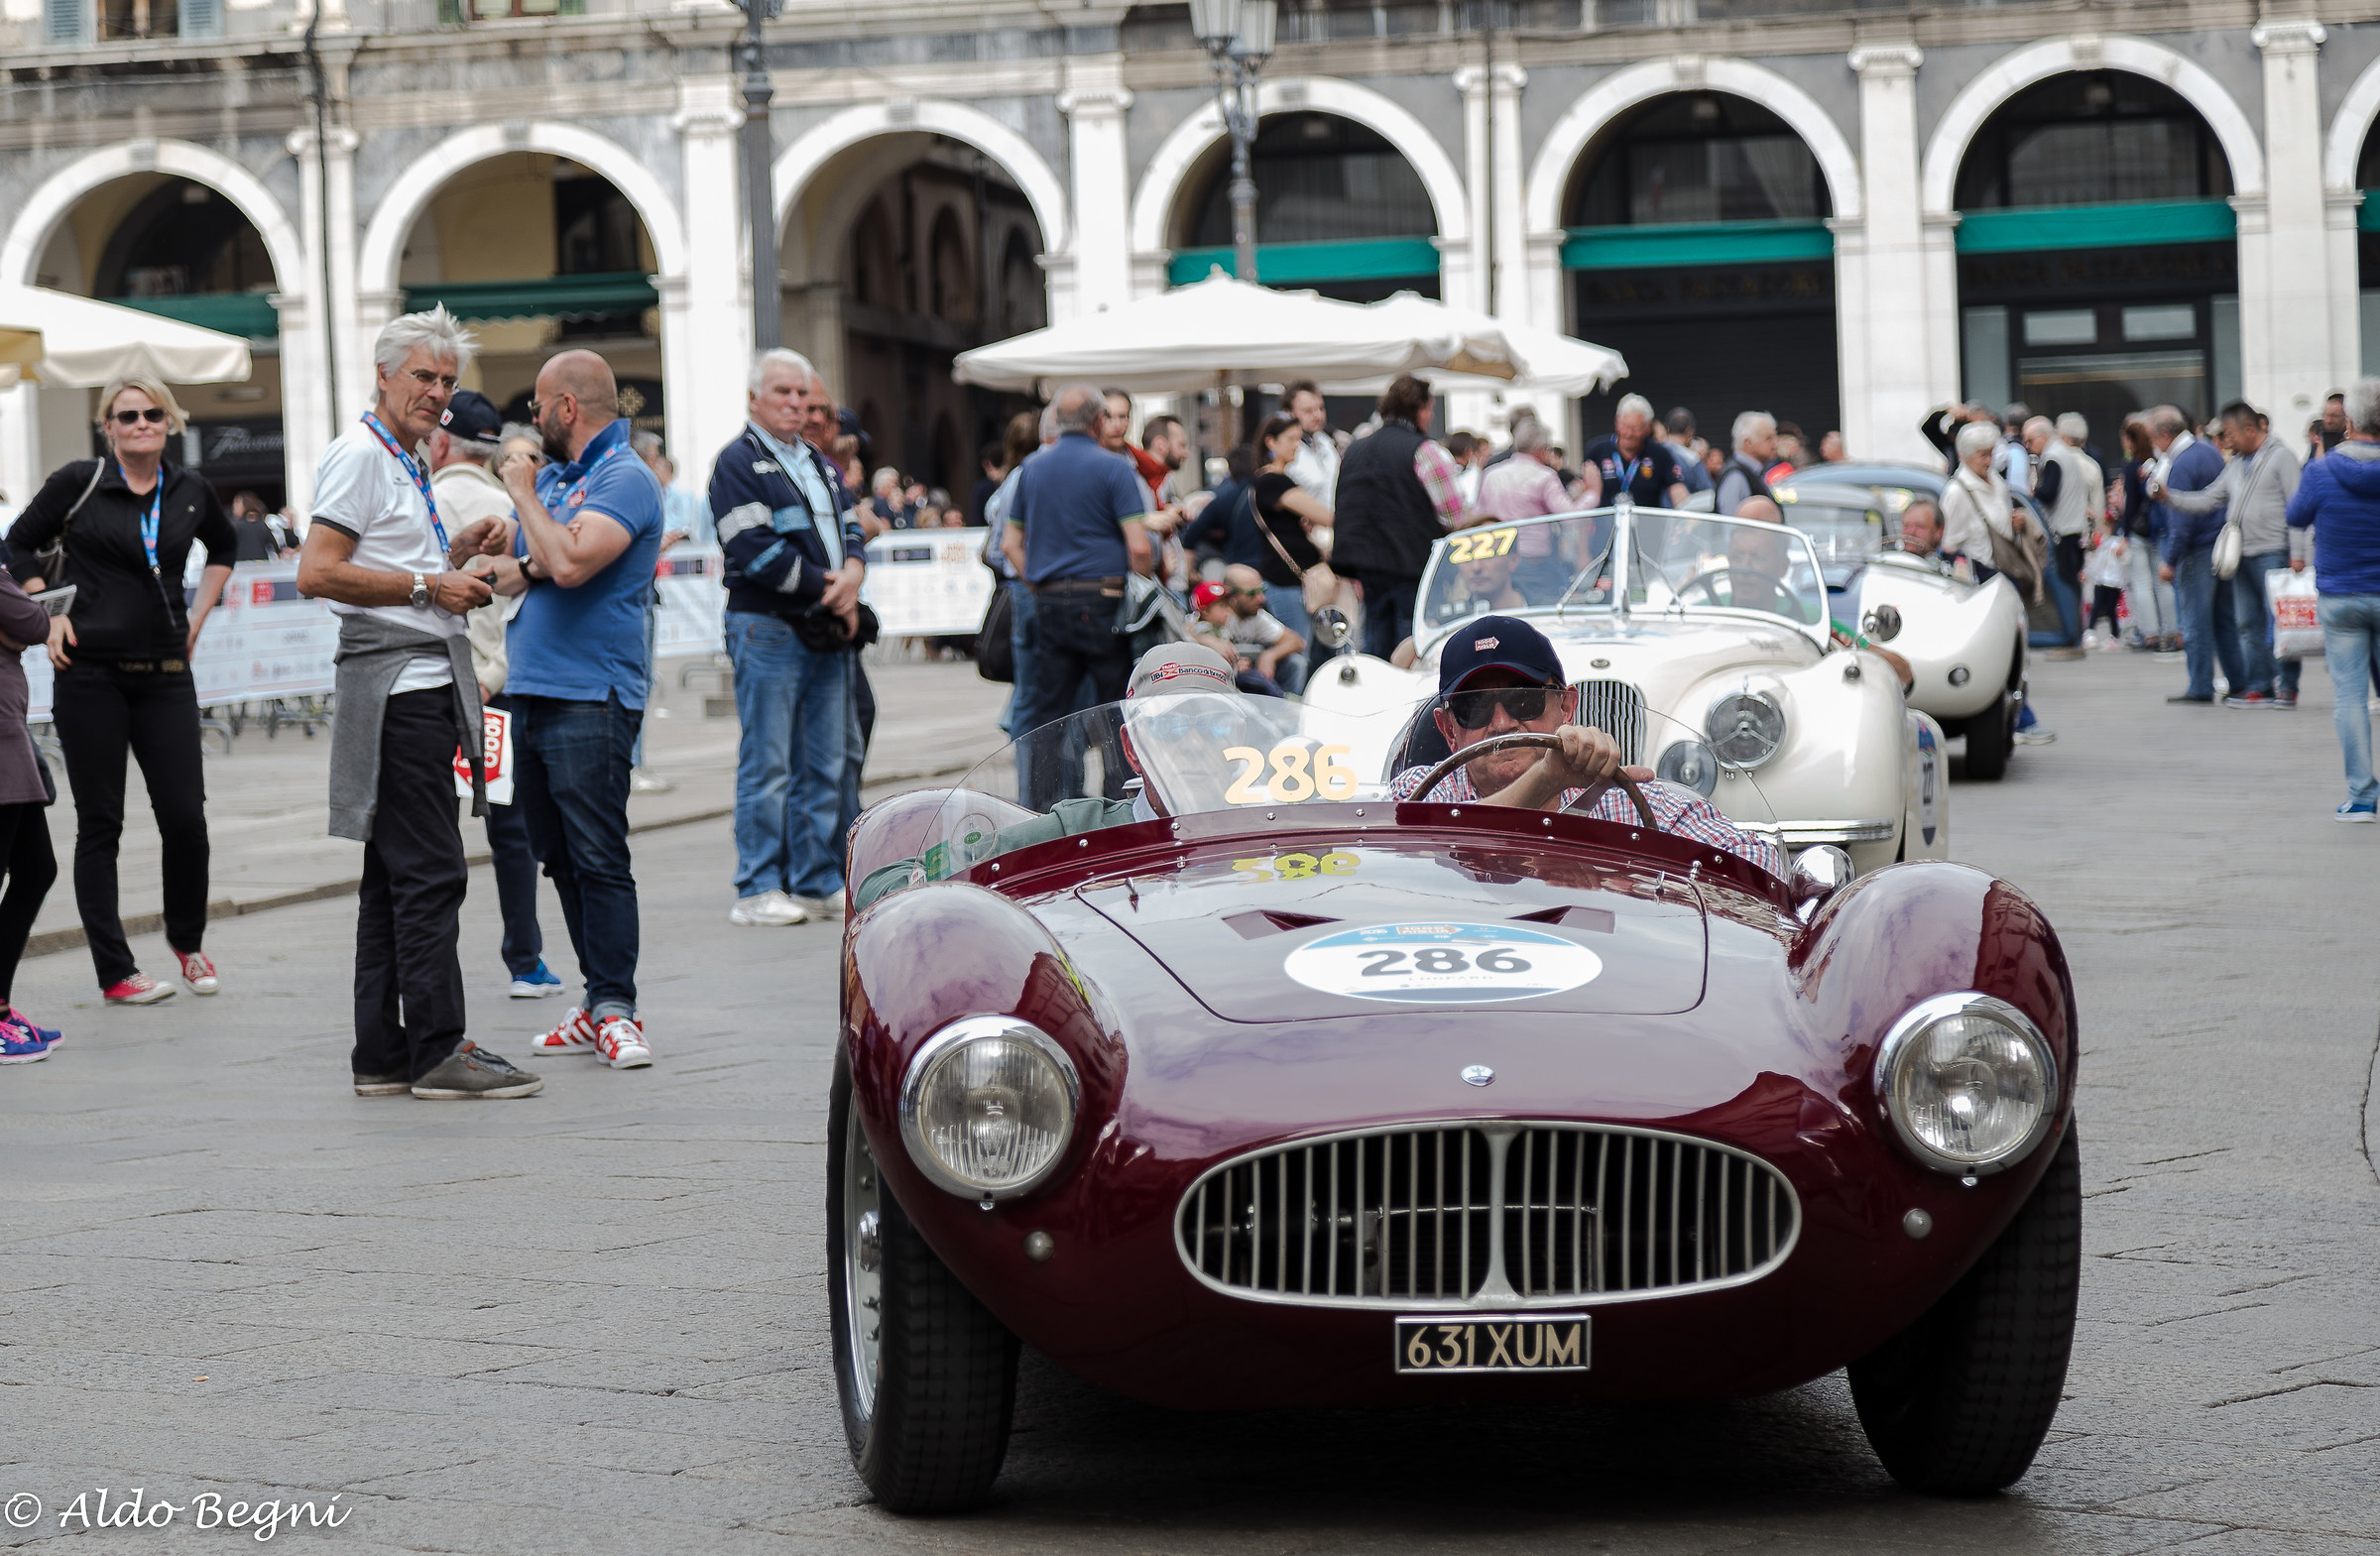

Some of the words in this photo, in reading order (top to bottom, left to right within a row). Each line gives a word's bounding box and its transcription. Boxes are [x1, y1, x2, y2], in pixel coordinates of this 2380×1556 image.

[1449, 528, 1517, 564] 227
[1150, 672, 1163, 682] UBI
[1222, 745, 1359, 805] 286
[1357, 948, 1533, 977] 286
[1407, 1325, 1477, 1368] 631
[1488, 1323, 1581, 1367] XUM
